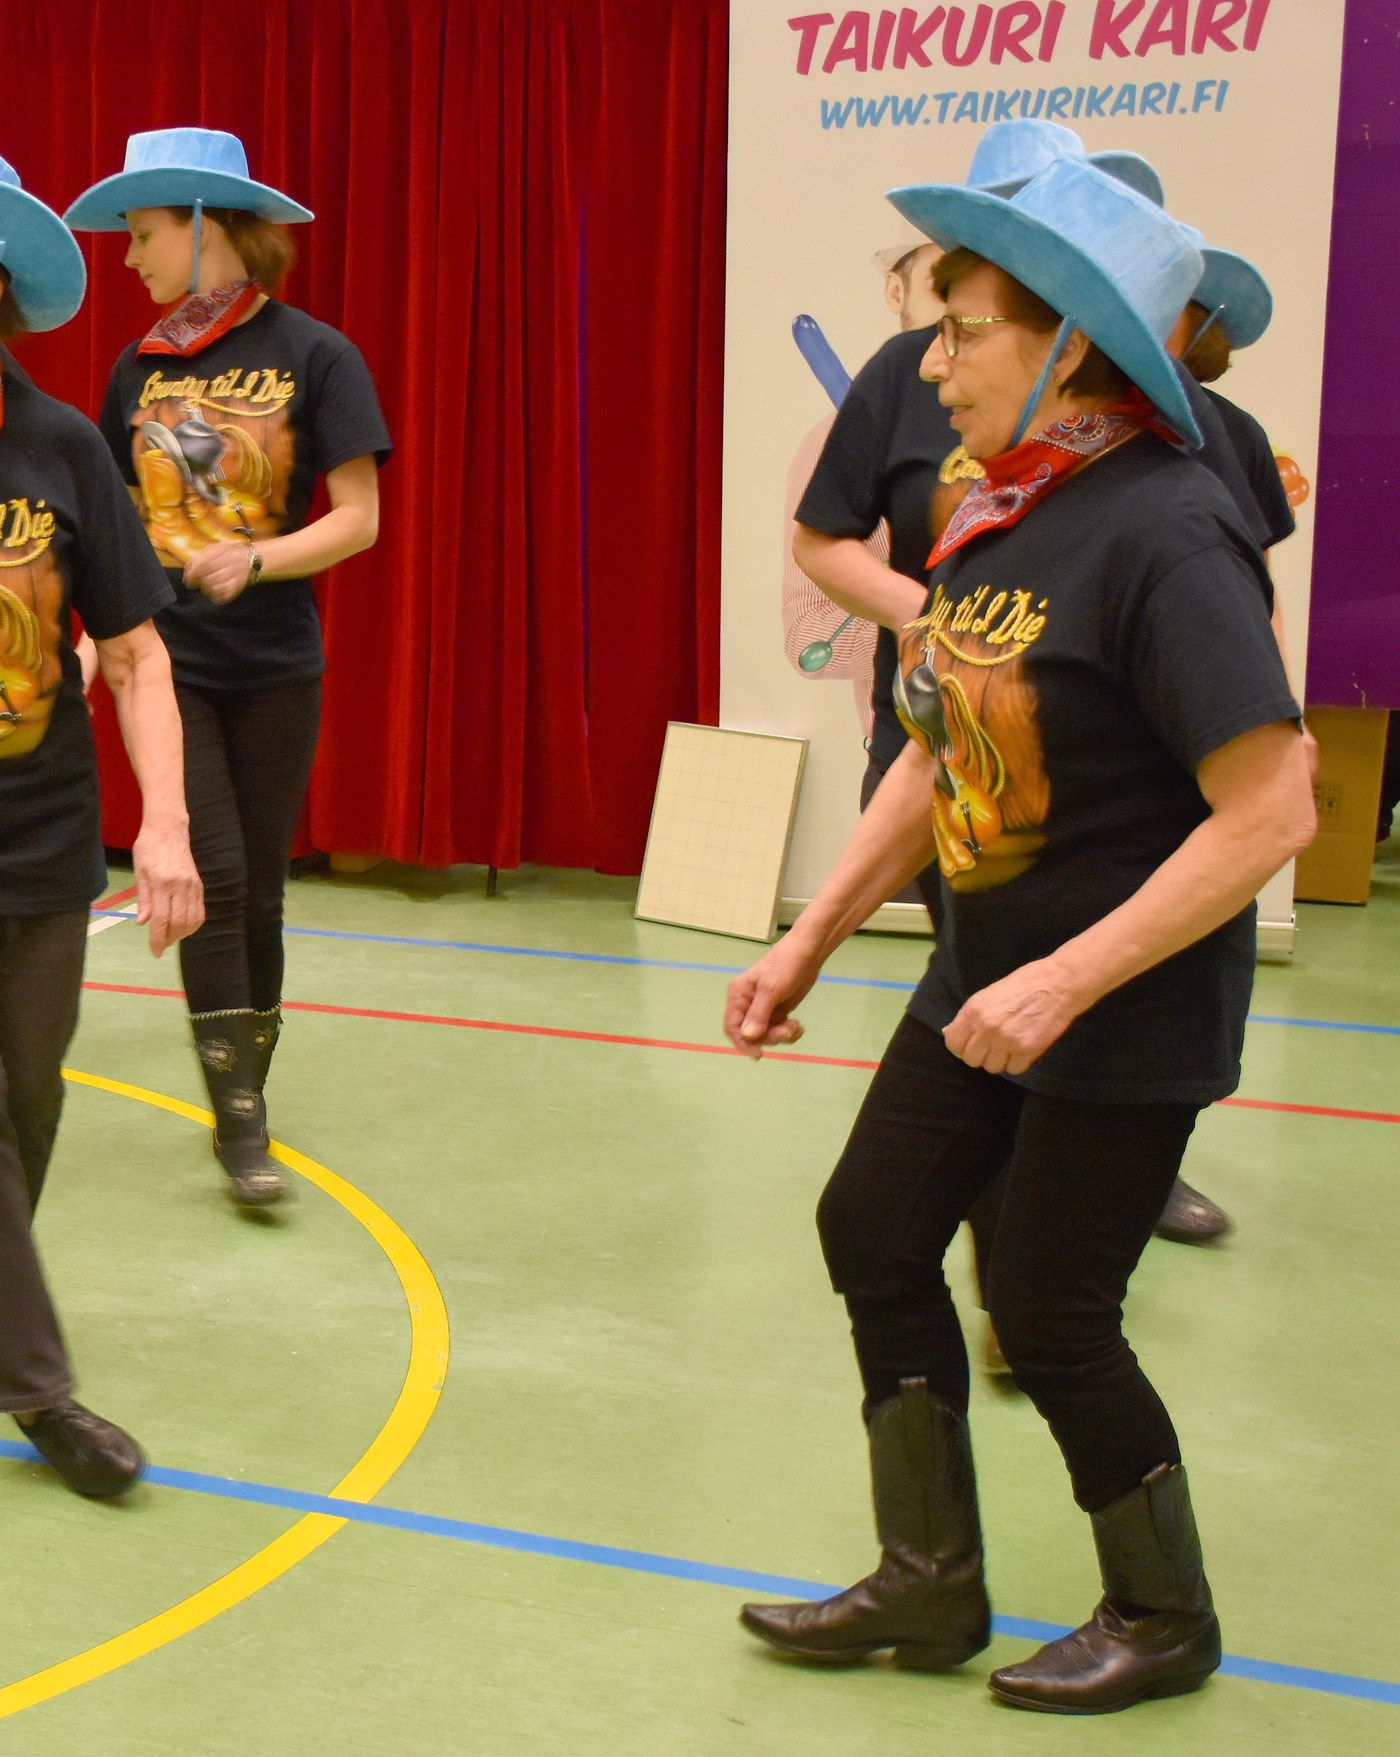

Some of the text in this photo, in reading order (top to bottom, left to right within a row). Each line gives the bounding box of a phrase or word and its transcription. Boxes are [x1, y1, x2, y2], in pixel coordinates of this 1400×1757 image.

[787, 0, 1270, 76] TAIKURI KARI
[820, 80, 1230, 130] WWW.TAIKURIKARI.FI
[138, 370, 209, 408] Country
[250, 368, 296, 403] Die
[3, 498, 56, 548] Die
[986, 588, 1048, 644] Die
